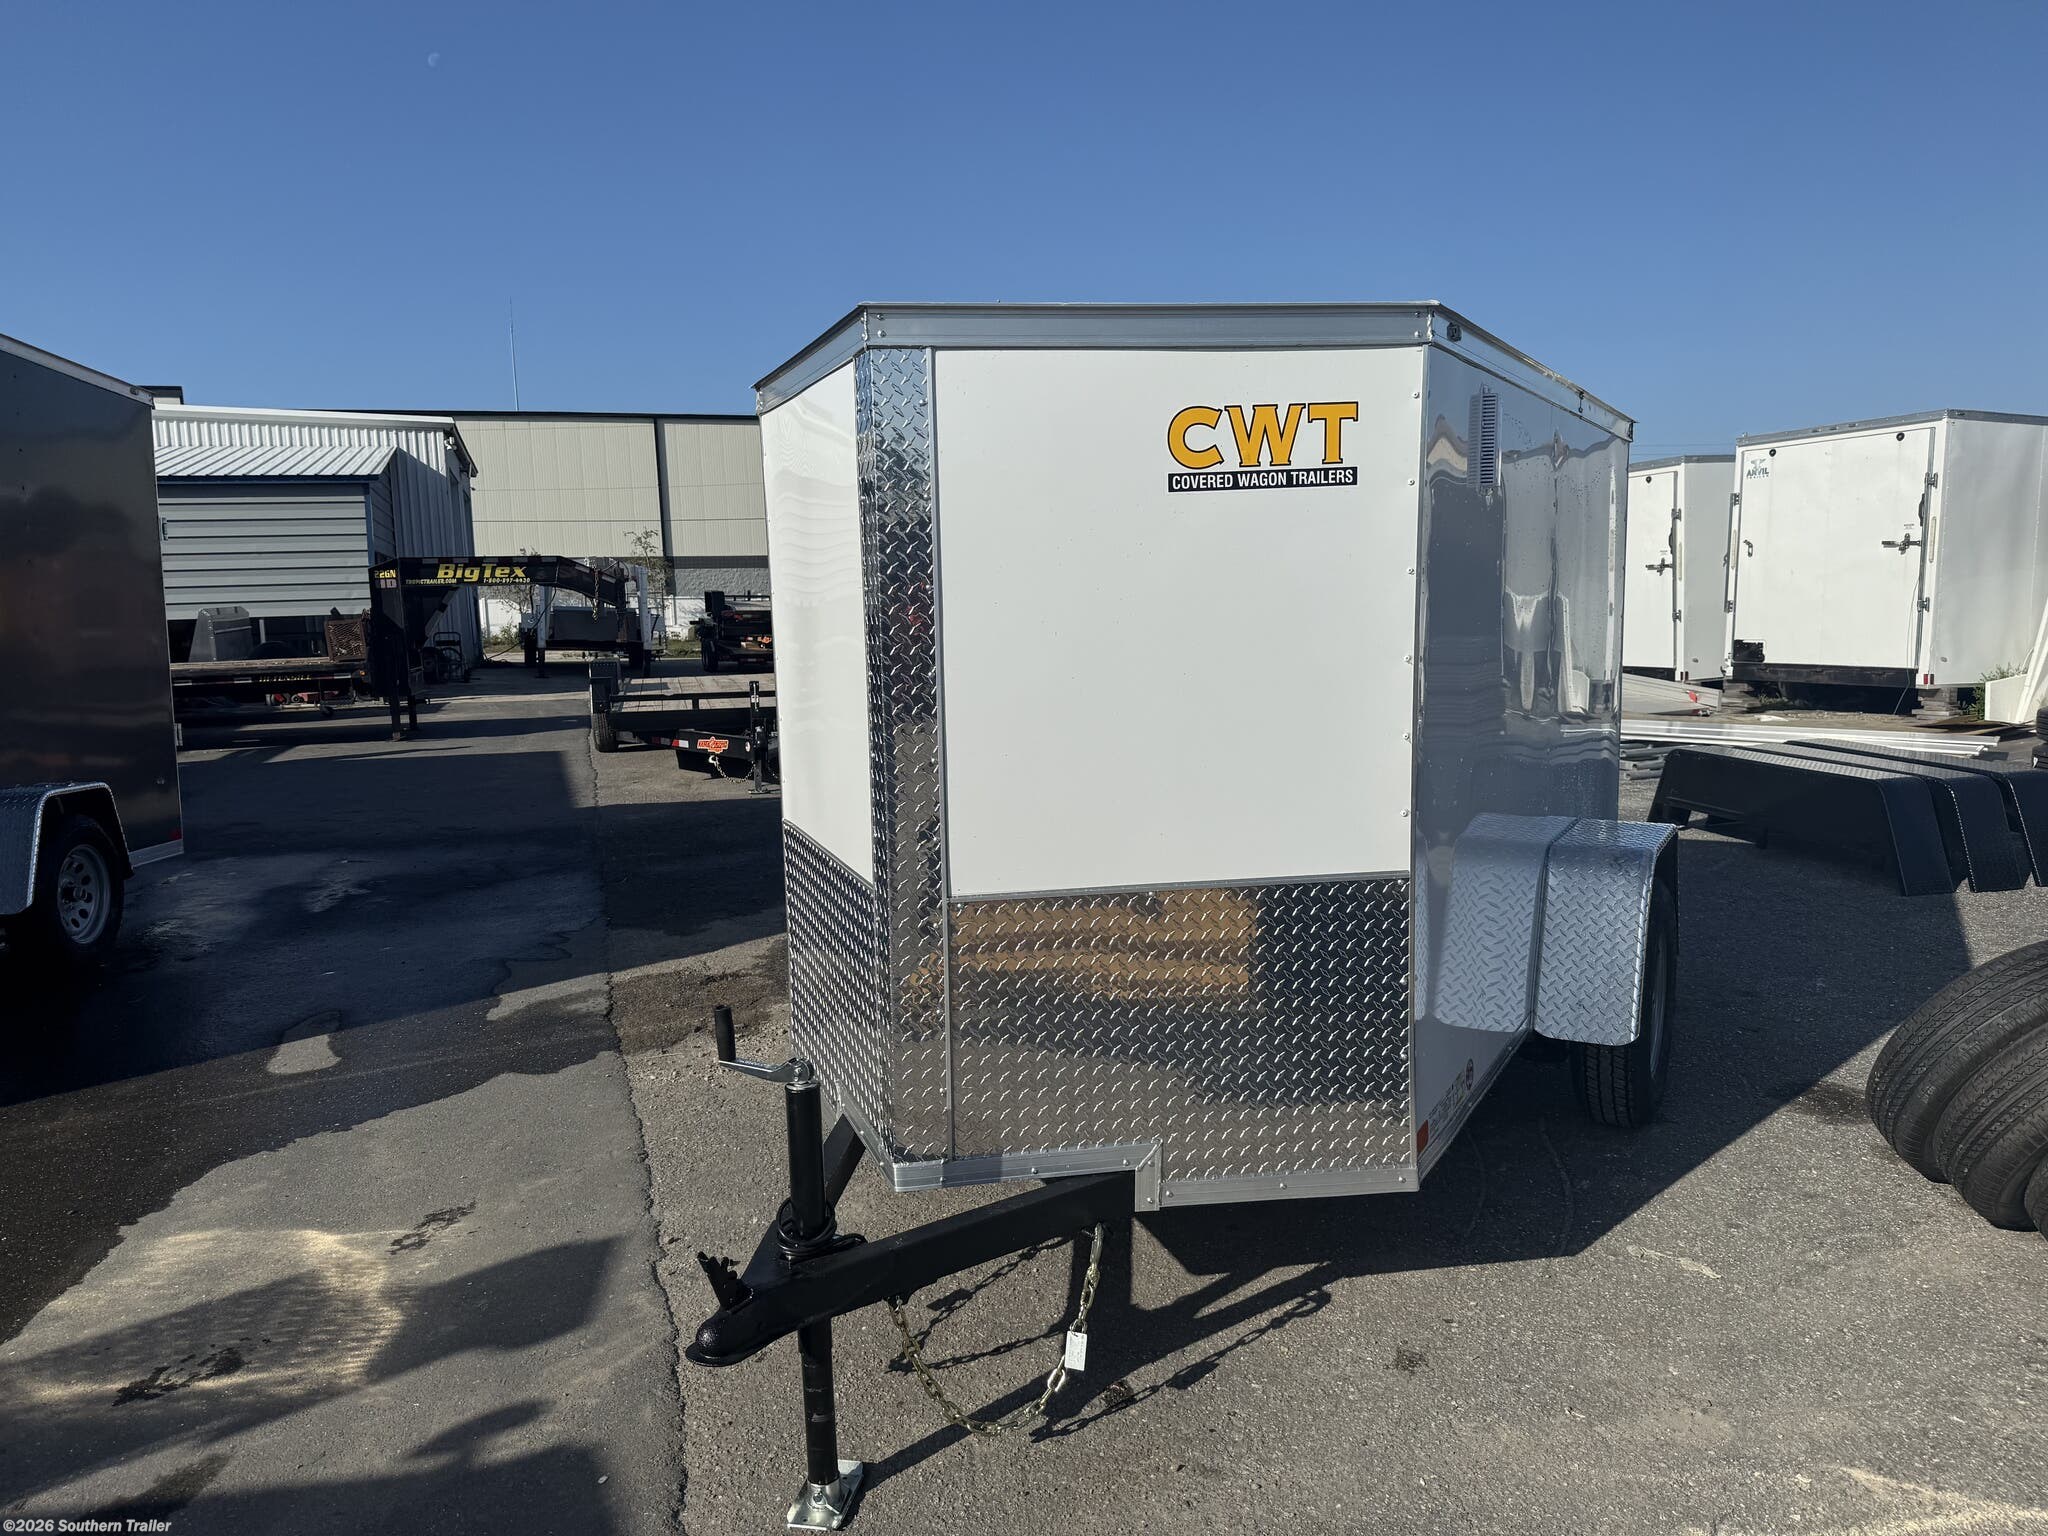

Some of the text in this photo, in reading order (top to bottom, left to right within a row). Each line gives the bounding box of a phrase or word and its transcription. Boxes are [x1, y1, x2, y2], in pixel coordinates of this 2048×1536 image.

[1167, 401, 1359, 470] CWT
[1172, 469, 1354, 490] COVERED WAGON TRAILERS
[1746, 467, 1770, 477] ANVIL
